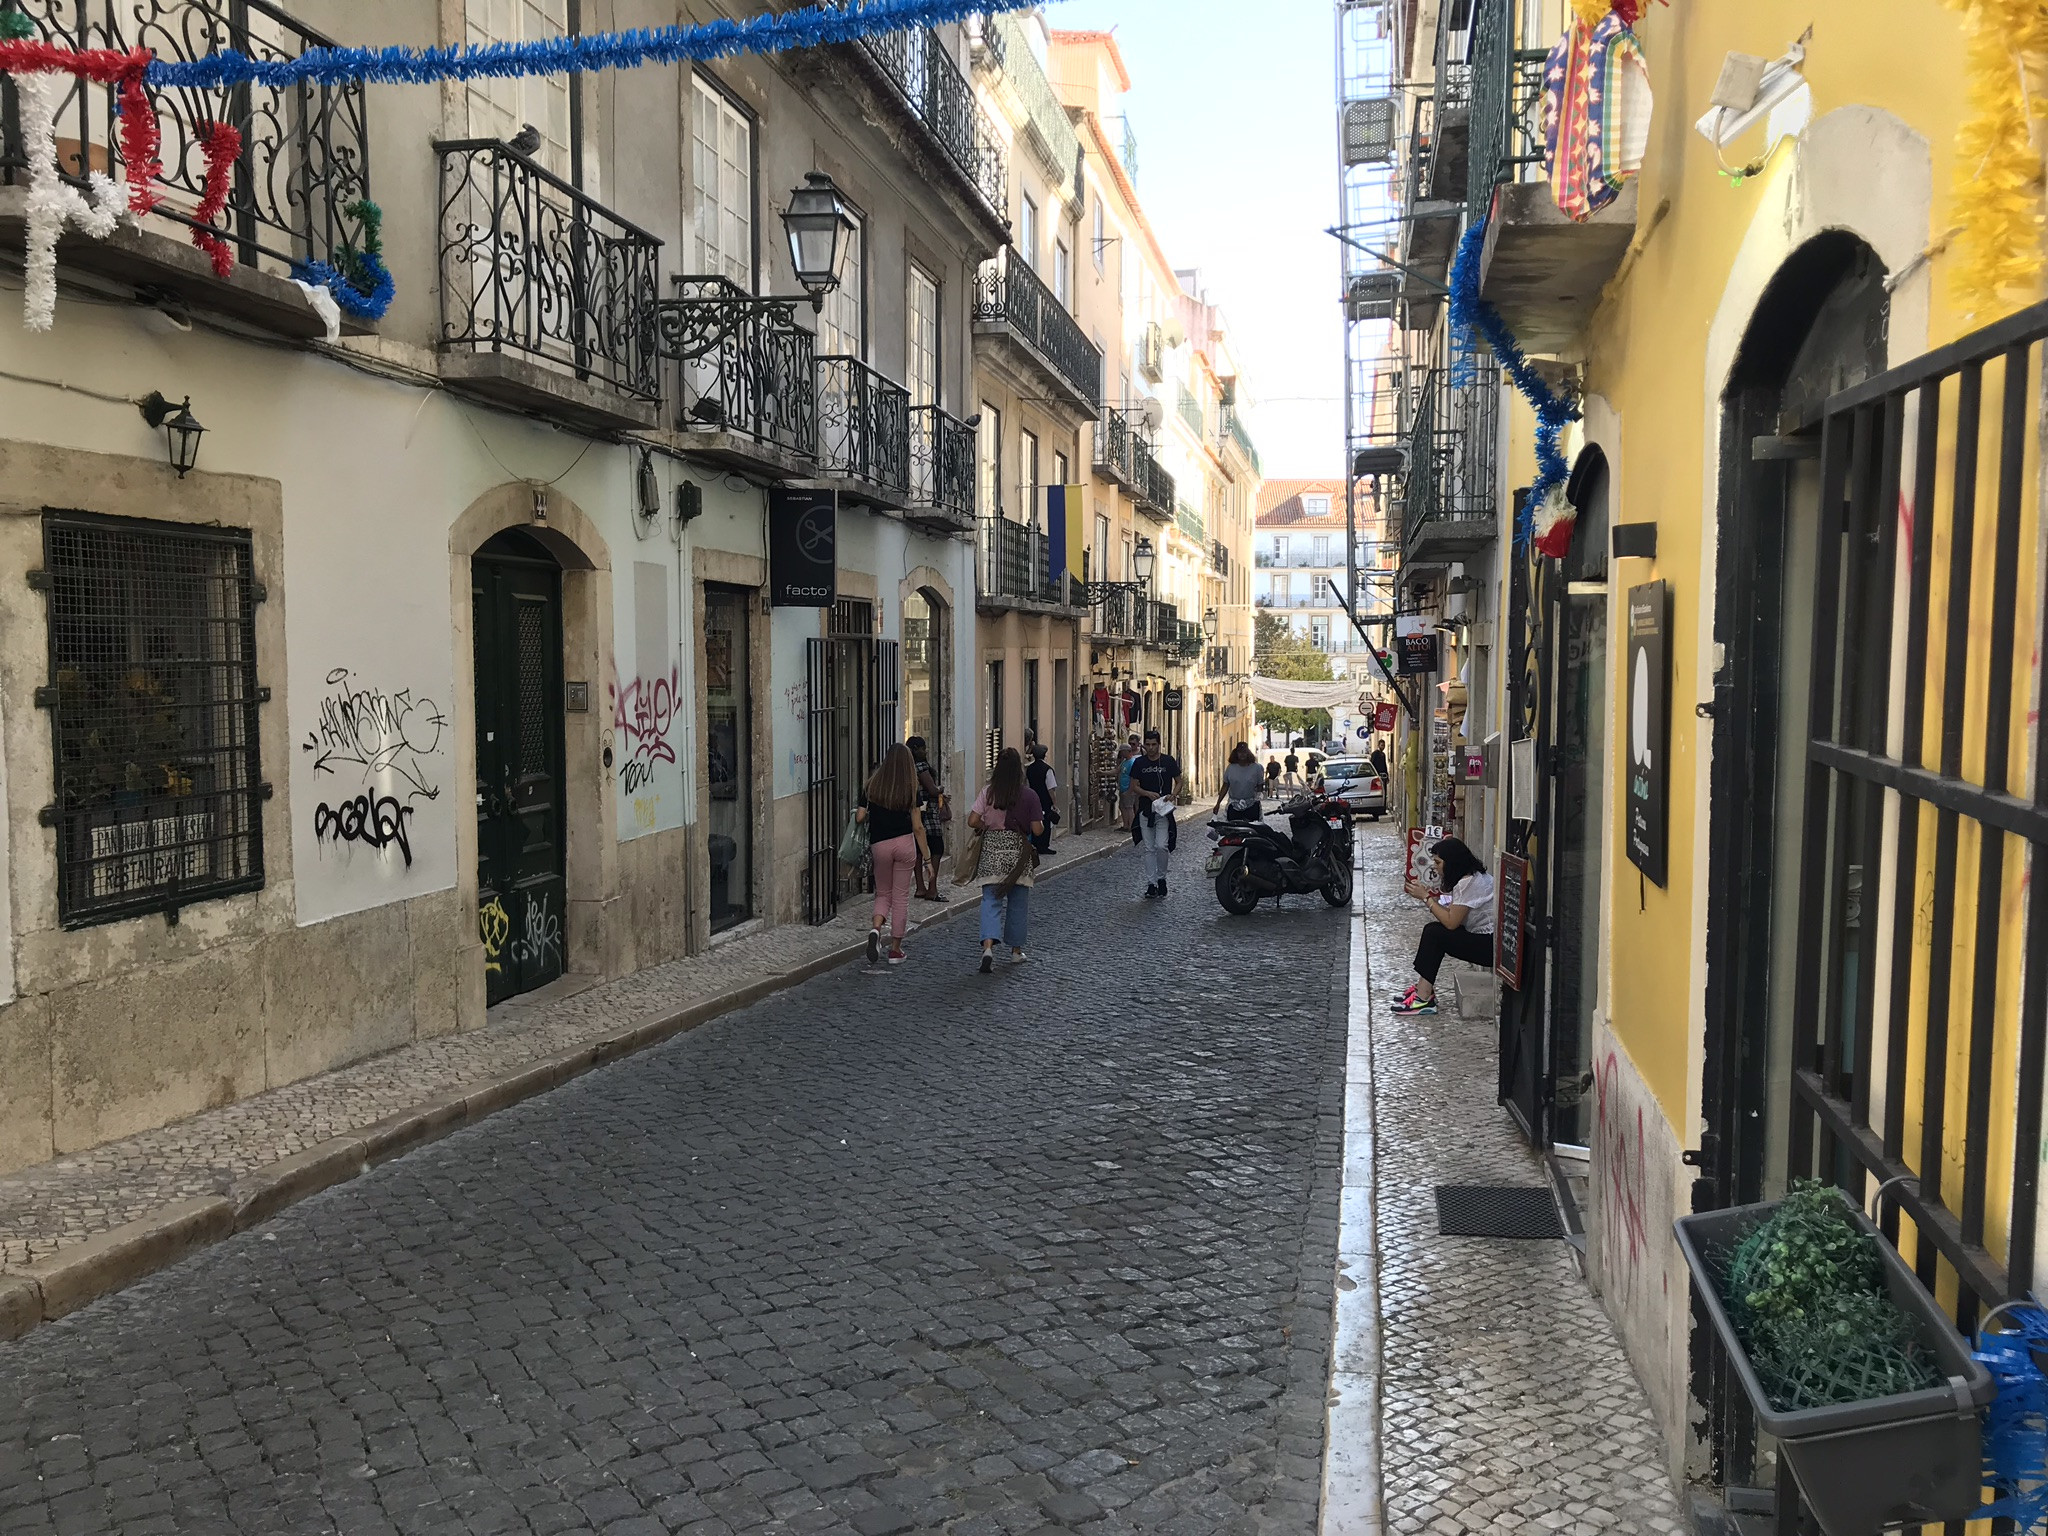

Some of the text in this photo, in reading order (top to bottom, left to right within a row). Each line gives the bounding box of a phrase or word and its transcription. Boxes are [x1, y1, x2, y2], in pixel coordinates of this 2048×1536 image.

[785, 584, 829, 597] facto
[1405, 637, 1429, 646] BACO
[1407, 644, 1429, 652] ALTO
[1426, 826, 1442, 838] 1€
